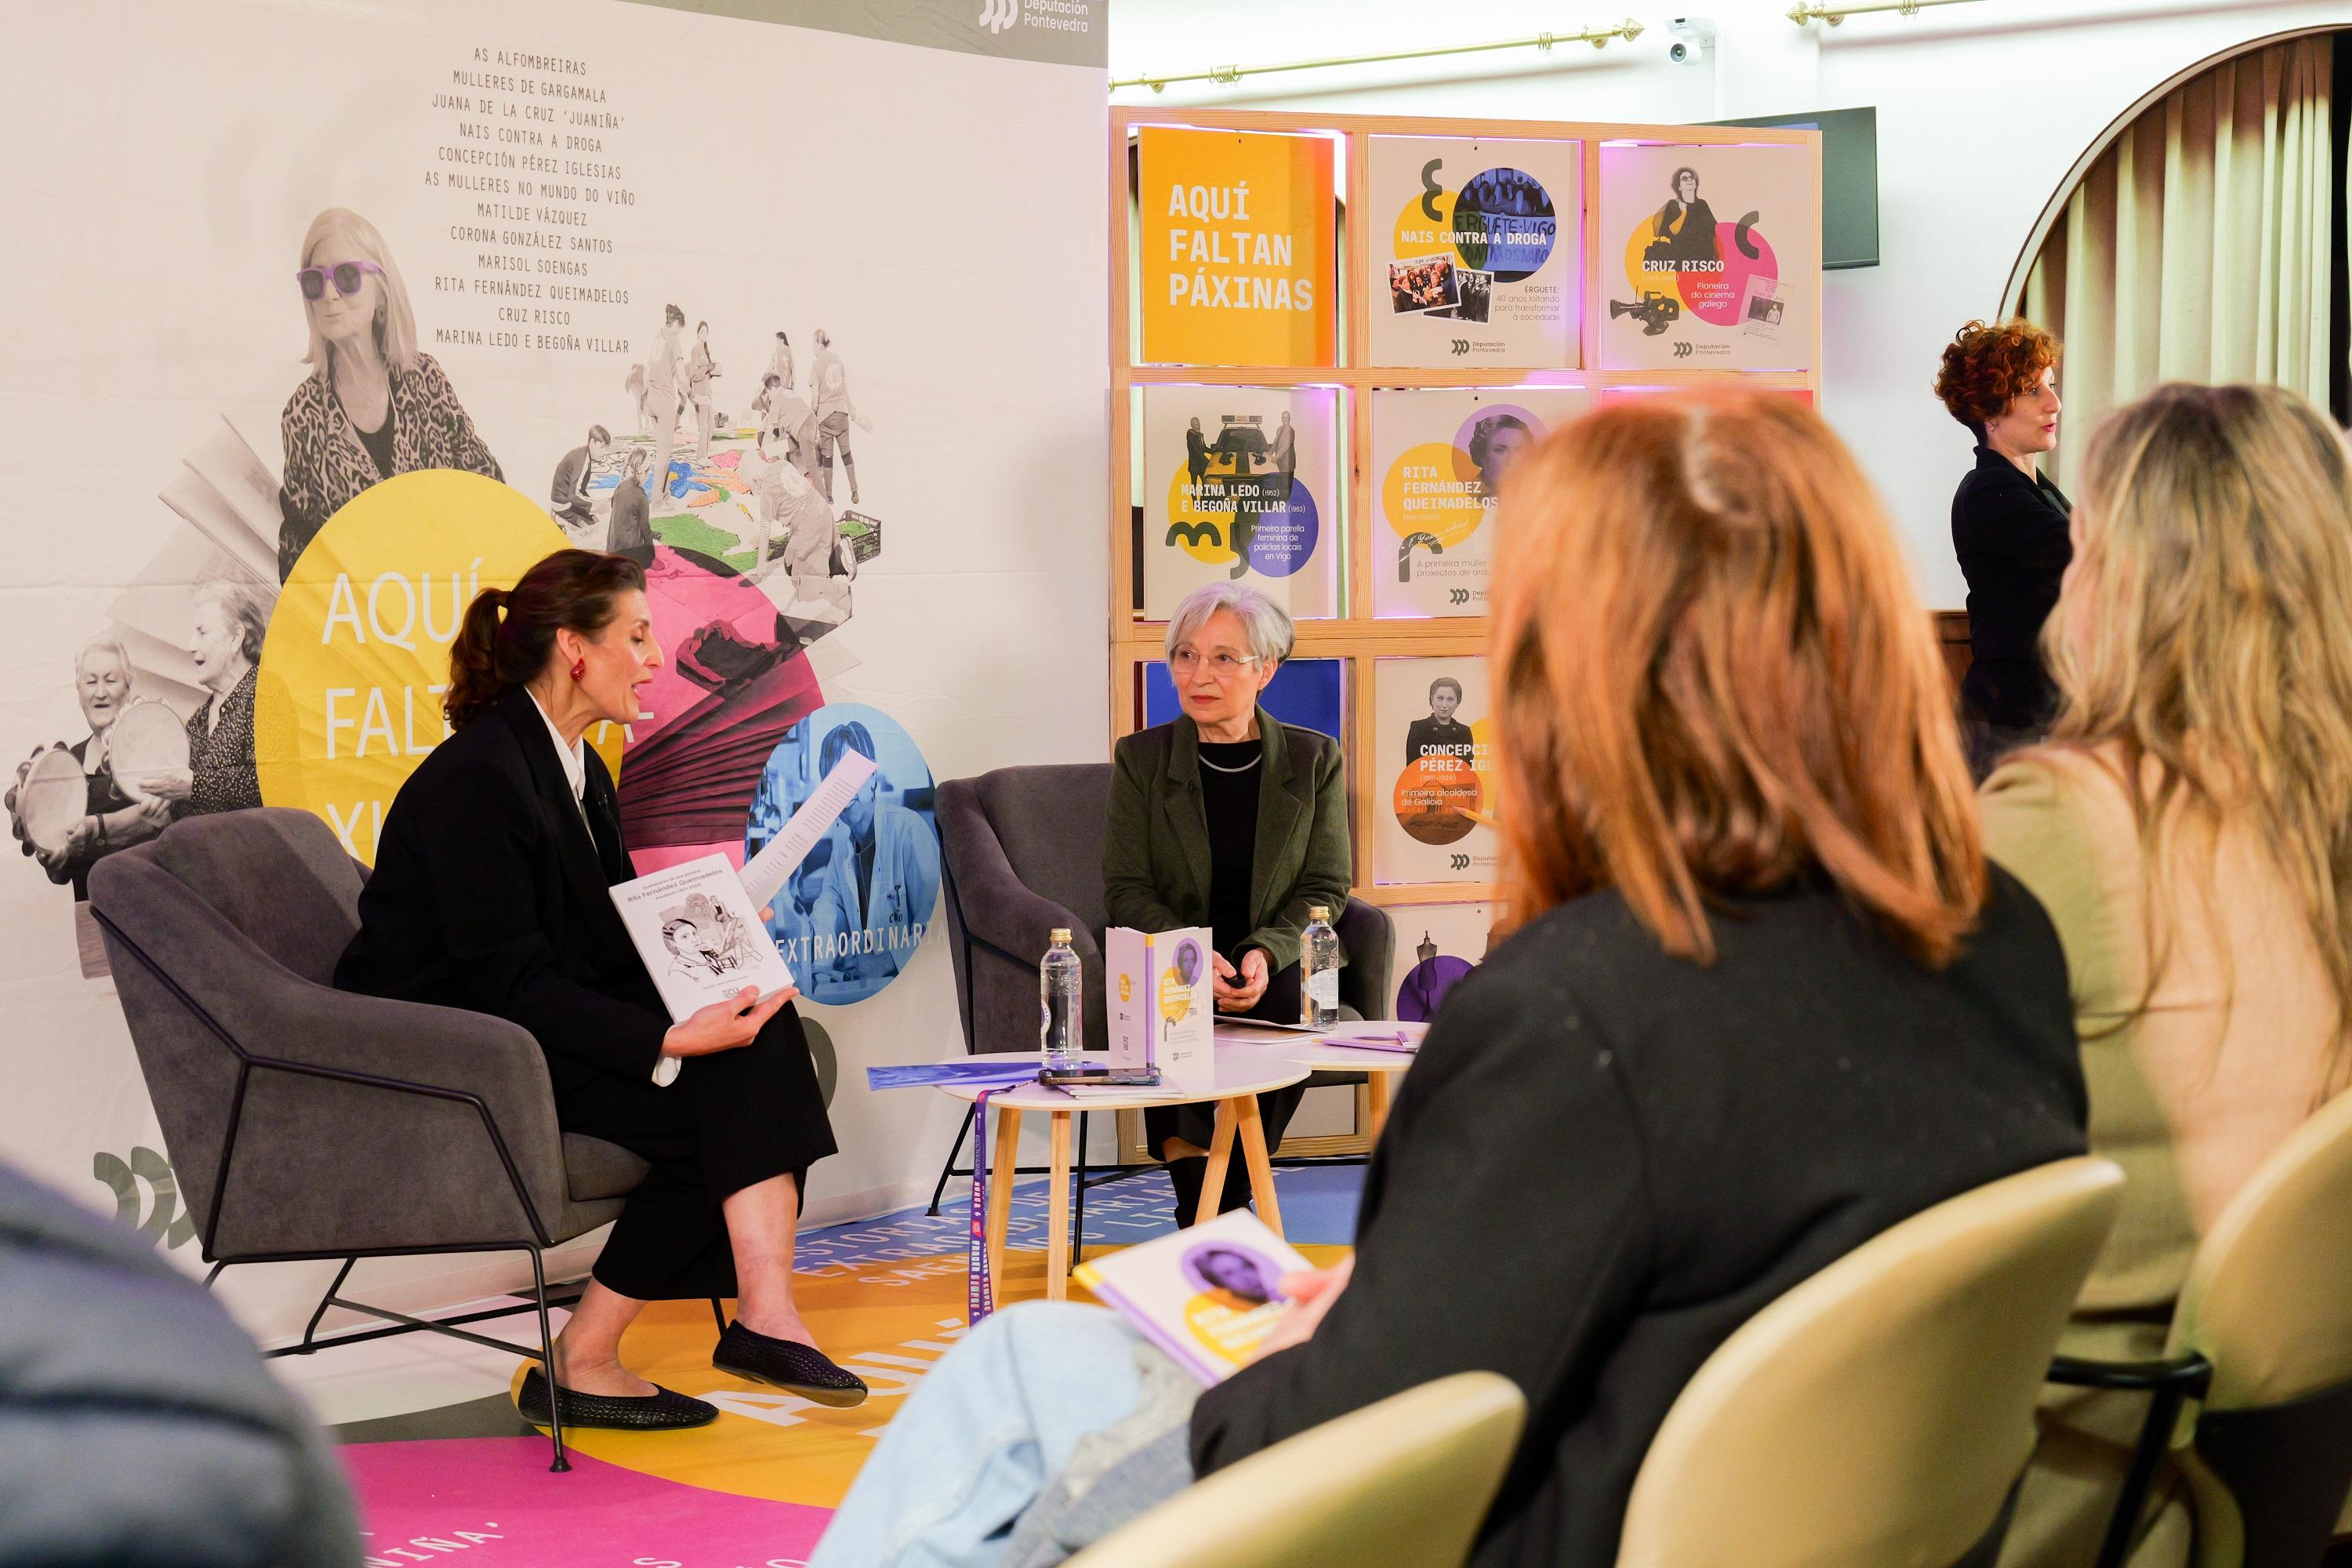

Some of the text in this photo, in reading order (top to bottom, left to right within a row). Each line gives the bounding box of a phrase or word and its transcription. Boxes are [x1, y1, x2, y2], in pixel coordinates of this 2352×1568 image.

[1024, 13, 1088, 33] Pontevedra
[474, 47, 586, 76] AS ALFOMBREIRAS
[453, 70, 606, 103] MULLERES DE GARGAMALA
[432, 93, 470, 112] JUANA
[480, 100, 493, 114] DE
[503, 102, 517, 118] LA
[525, 105, 554, 122] CRUZ
[459, 123, 602, 153] NAIS CONTRA A DROGA
[439, 147, 621, 180] CONCEPCIÓN PÉREZ IGLESIAS
[425, 171, 635, 205] AS MULLERES NO MUNDO DO VIÑO
[1168, 180, 1250, 223] AQUÍ
[477, 202, 587, 227] MATILDE VÁZQUEZ
[451, 226, 613, 253] CORONA GONZÁLEZ SANTOS
[1401, 230, 1547, 245] NAIS CONTRA A DROGA
[1170, 229, 1292, 267] FALTAN
[478, 254, 588, 277] MARISOL SOENGAS
[1642, 260, 1725, 273] CRUZ RISCO
[435, 277, 630, 305] RITA FERNÁNDEZ QUEIMADELOS
[1170, 267, 1313, 311] PÁXINAS
[1698, 300, 1727, 310] galego
[499, 307, 570, 325] CRUZ RISCO
[437, 328, 630, 354] MARINA LEDO E BEGOÑA VILLAR
[1403, 466, 1438, 478] RITA
[1181, 484, 1225, 496] MARINA
[1231, 485, 1260, 497] LEDO
[1403, 480, 1482, 494] FERNÁNDEZ
[1181, 500, 1189, 513] E
[1194, 496, 1238, 513] BEGOÑA
[1243, 501, 1287, 514] VILLAR
[1403, 496, 1498, 511] QUEIMADELOS
[1280, 525, 1305, 534] parella
[1276, 553, 1291, 561] Vigo
[1425, 560, 1459, 568] primeira
[1417, 570, 1457, 579] proxectos
[1420, 744, 1490, 756] CONCEPCI
[1420, 757, 1464, 771] PÉREZ
[627, 869, 724, 903] Rita Fernández Queimadelos
